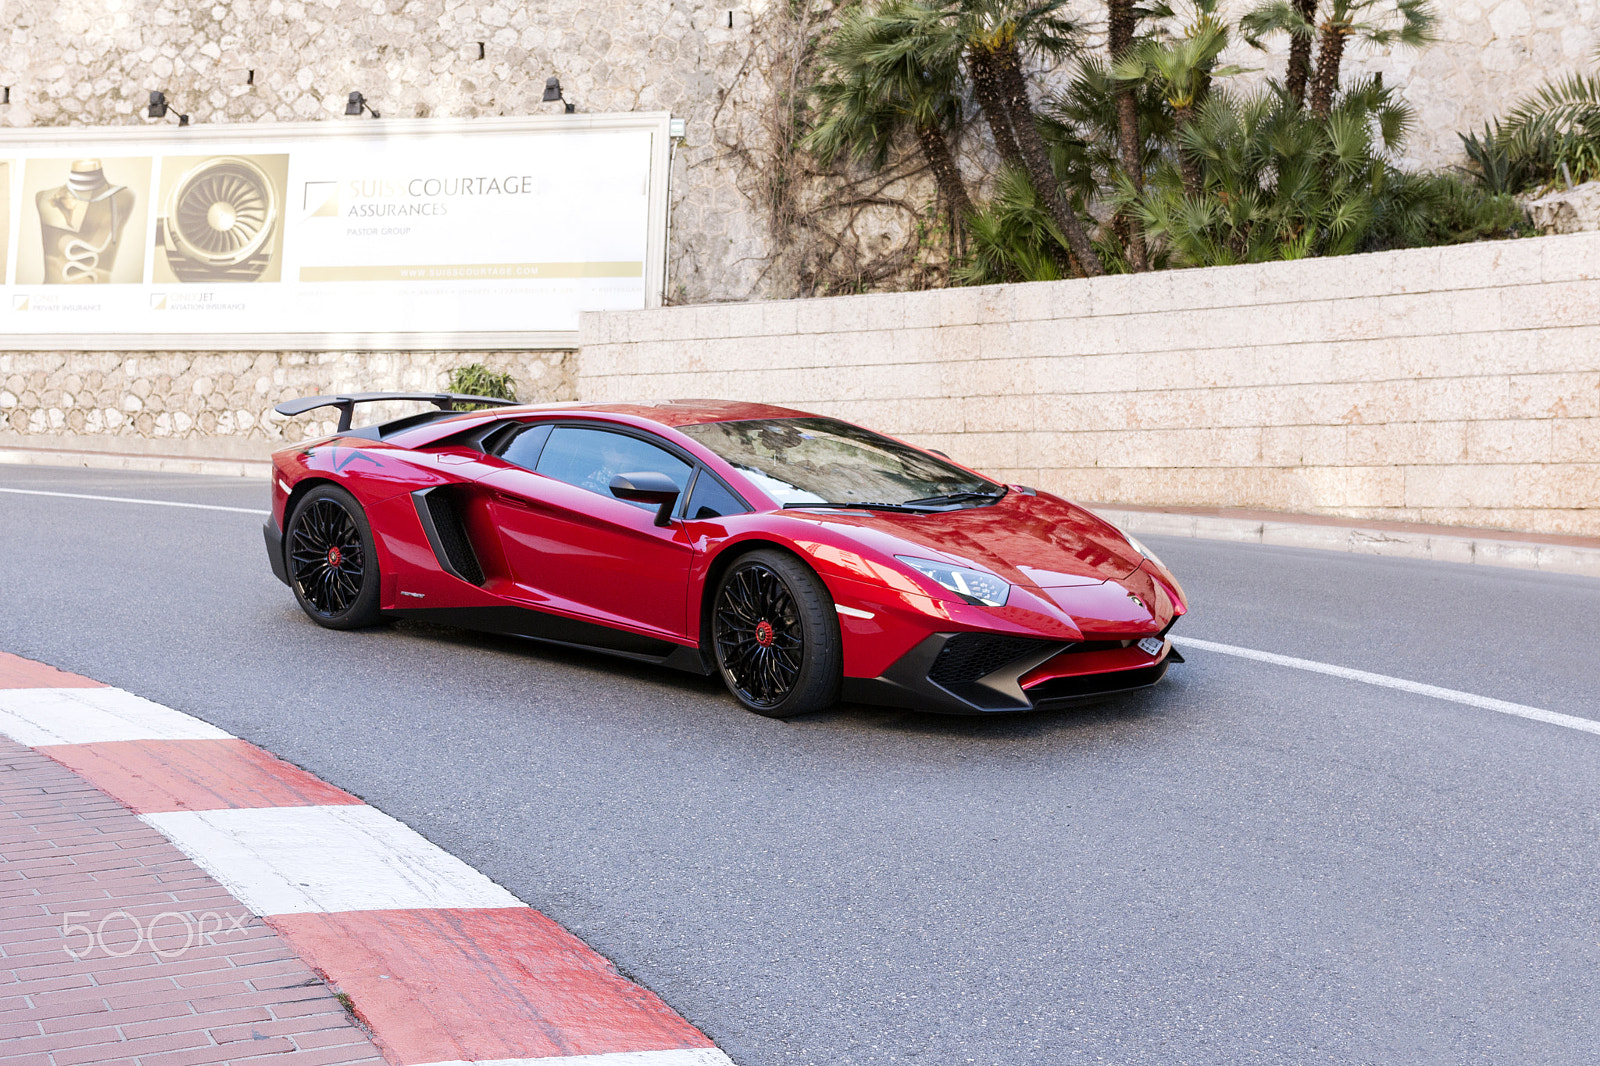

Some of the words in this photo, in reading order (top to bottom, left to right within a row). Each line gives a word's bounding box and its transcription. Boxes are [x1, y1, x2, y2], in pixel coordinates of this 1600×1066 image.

[349, 176, 532, 199] SUISSCOURTAGE
[347, 202, 448, 217] ASSURANCES
[347, 227, 378, 237] PASTOR
[381, 226, 411, 236] GROUP
[400, 266, 539, 277] WWW.SUISSCOURTAGE.COM
[170, 303, 204, 311] AVIATION
[206, 303, 246, 311] INSURANCE
